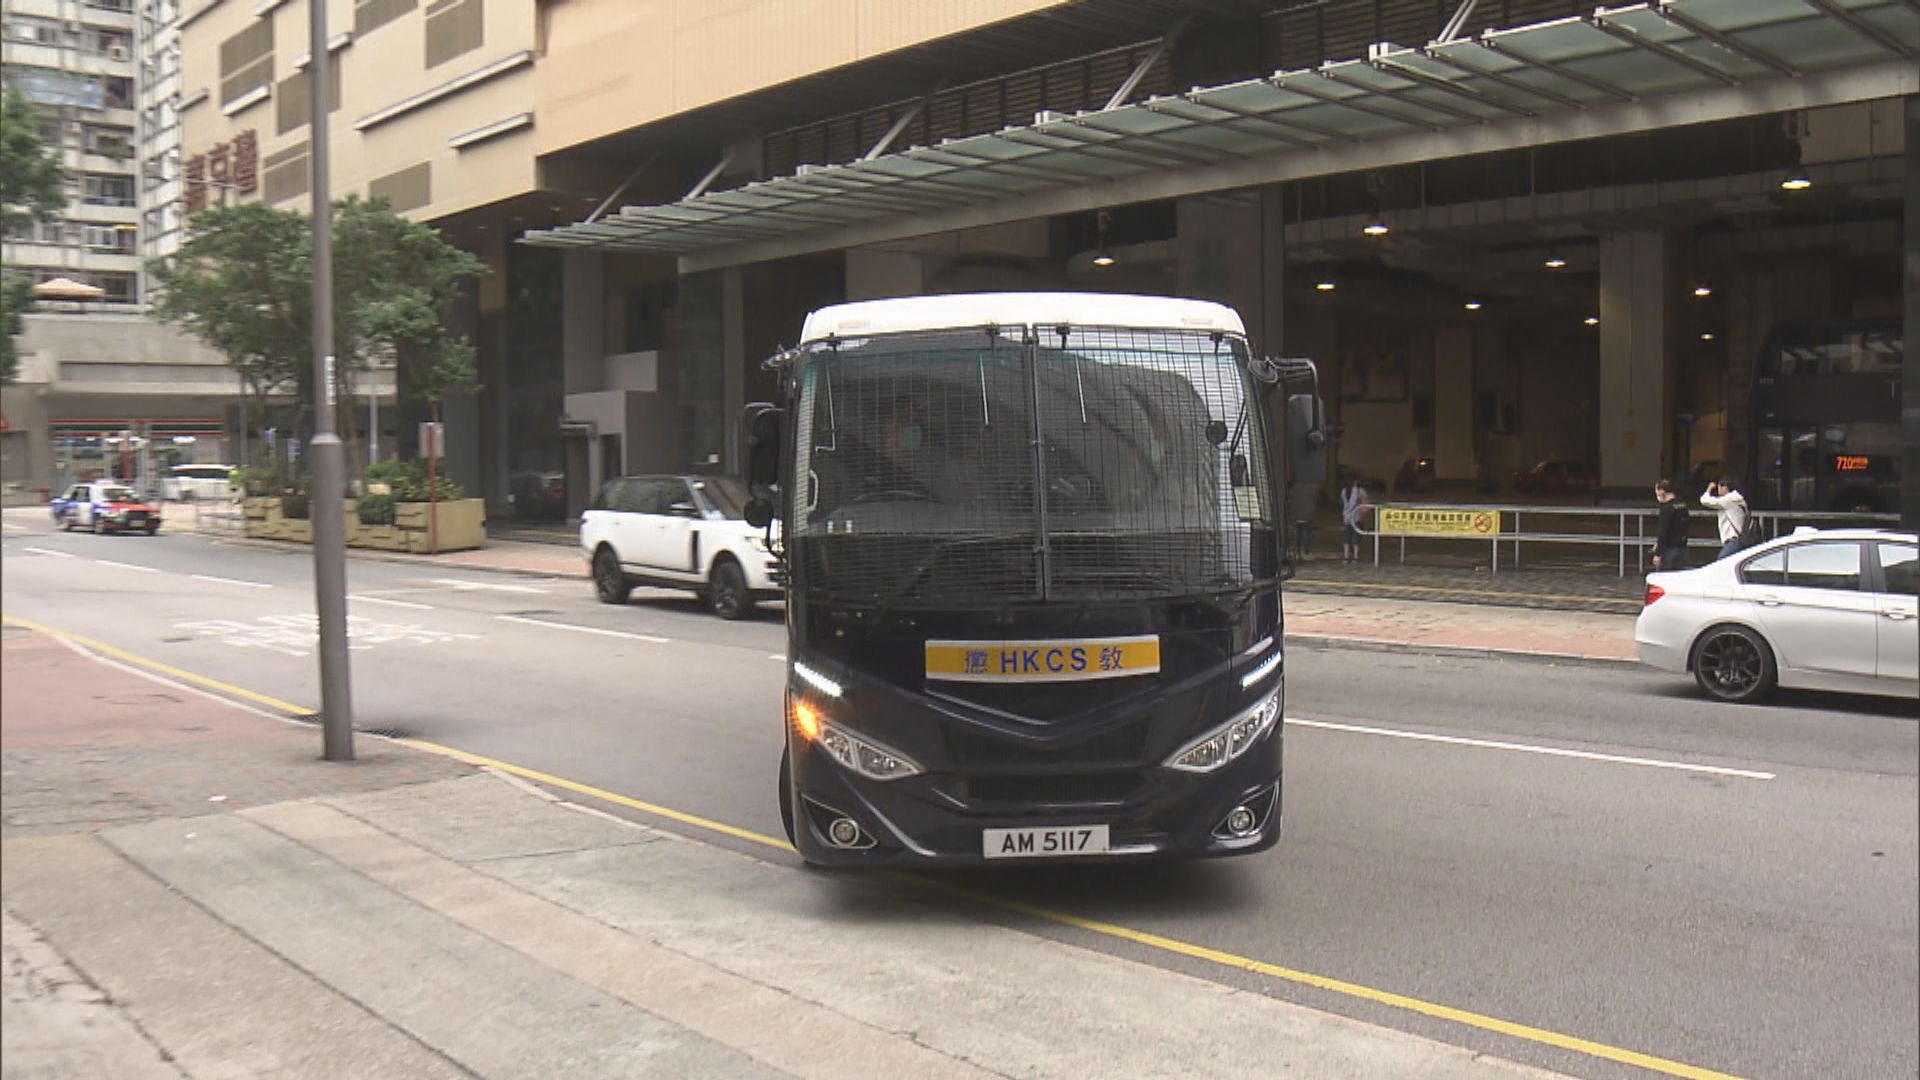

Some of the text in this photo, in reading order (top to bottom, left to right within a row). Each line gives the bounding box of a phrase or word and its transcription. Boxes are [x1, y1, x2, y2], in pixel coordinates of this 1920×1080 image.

[1000, 648, 1087, 673] HKCS
[1001, 830, 1092, 853] AM 5117
